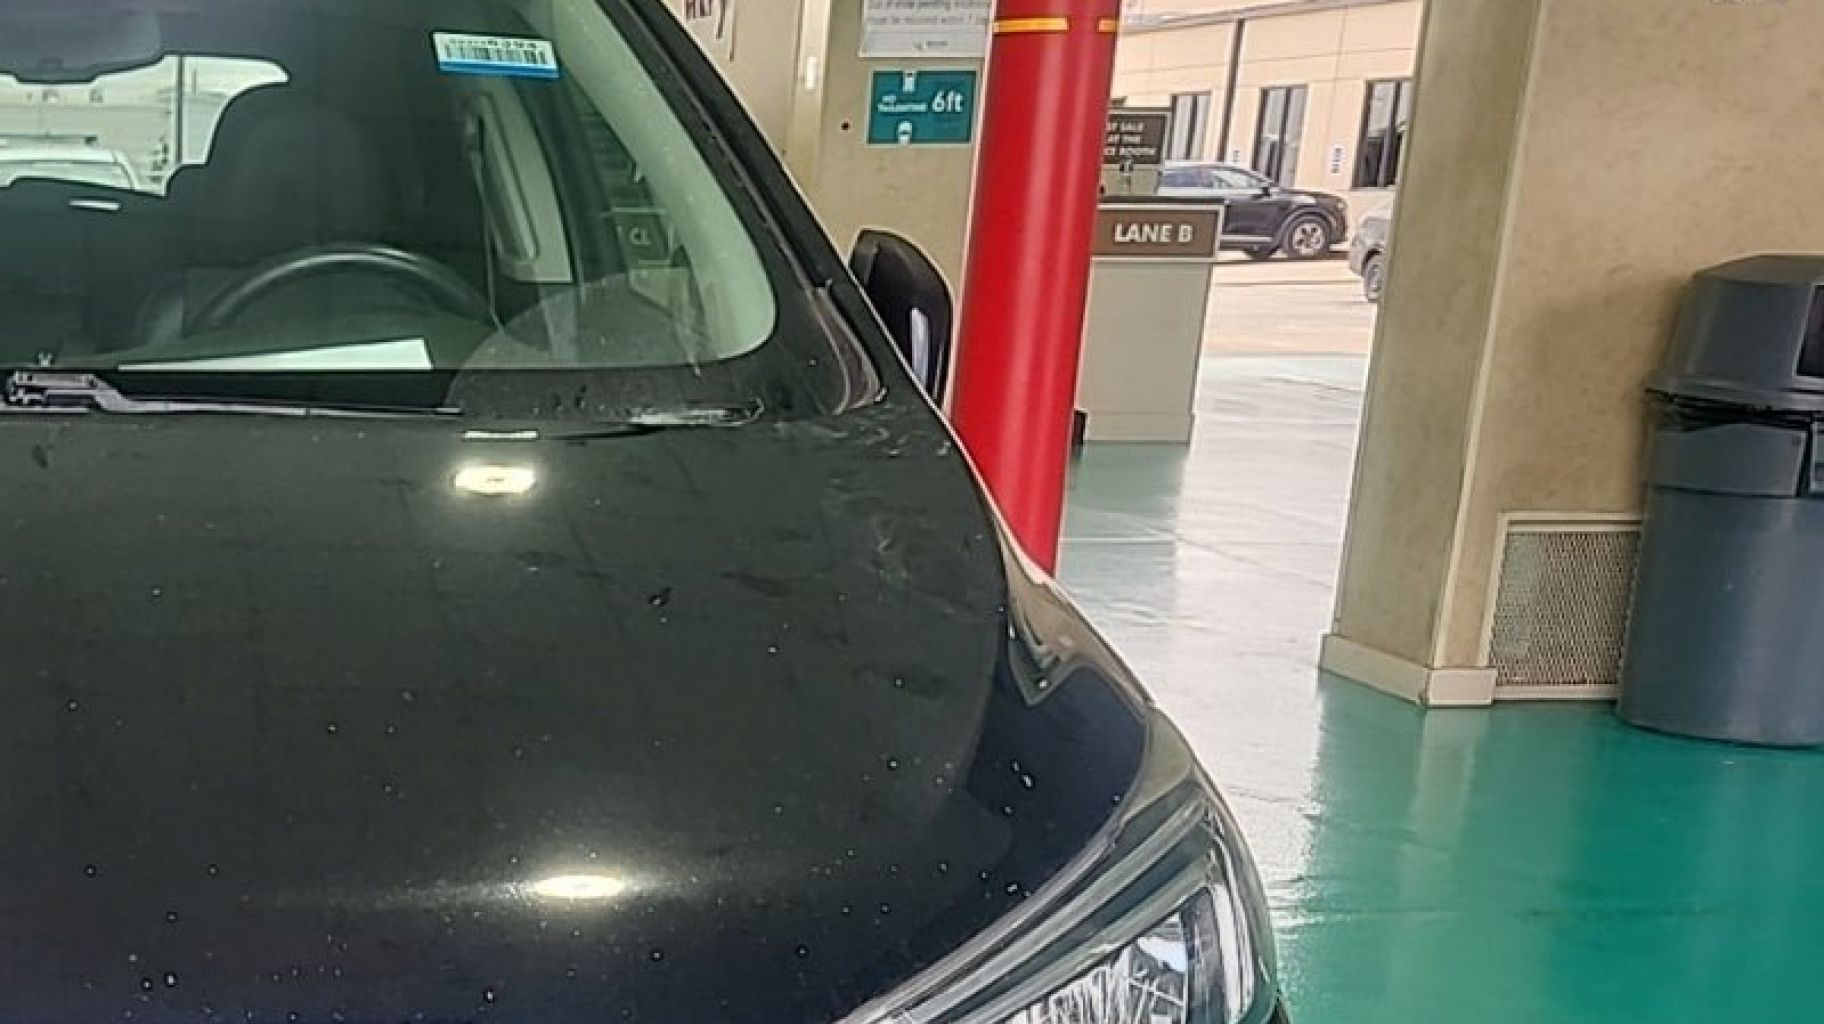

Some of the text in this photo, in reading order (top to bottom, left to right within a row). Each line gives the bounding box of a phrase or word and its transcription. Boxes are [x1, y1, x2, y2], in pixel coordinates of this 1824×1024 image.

[932, 91, 963, 112] 6ft
[1115, 223, 1192, 242] LANE B
